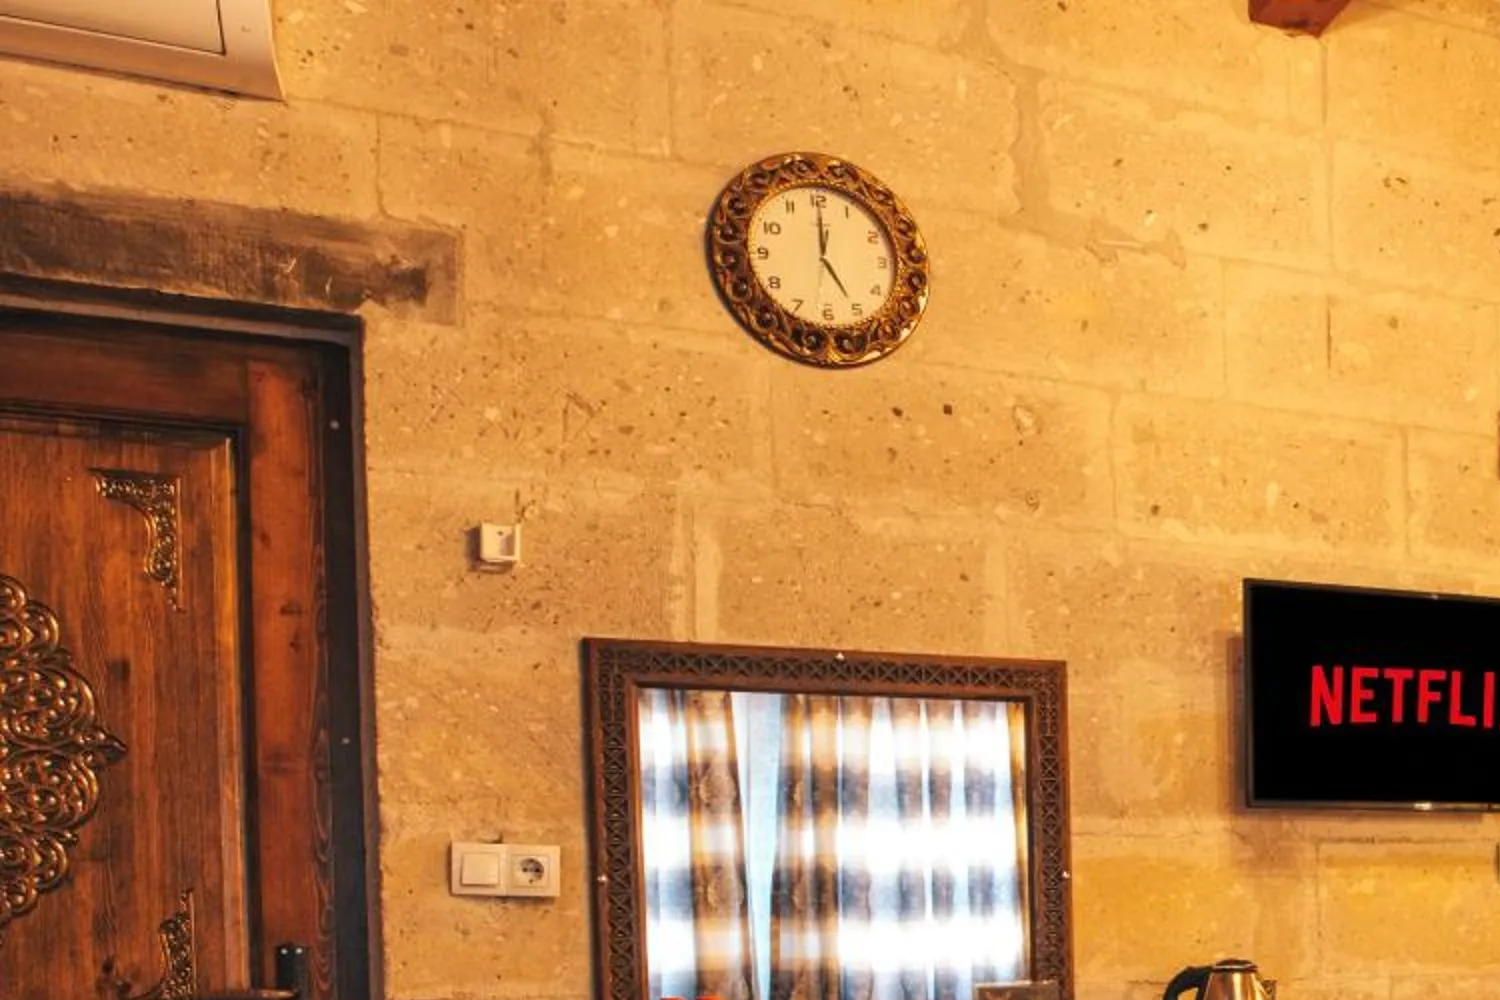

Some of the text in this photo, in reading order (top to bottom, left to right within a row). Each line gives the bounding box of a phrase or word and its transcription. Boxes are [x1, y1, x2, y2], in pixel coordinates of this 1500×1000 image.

[785, 199, 795, 214] 11
[809, 194, 827, 208] 12
[763, 222, 781, 235] 10
[867, 230, 878, 244] 2
[757, 247, 769, 260] 9
[768, 276, 781, 289] 8
[870, 284, 881, 296] 4
[792, 299, 804, 312] 7
[851, 303, 862, 316] 5
[822, 304, 834, 321] 6
